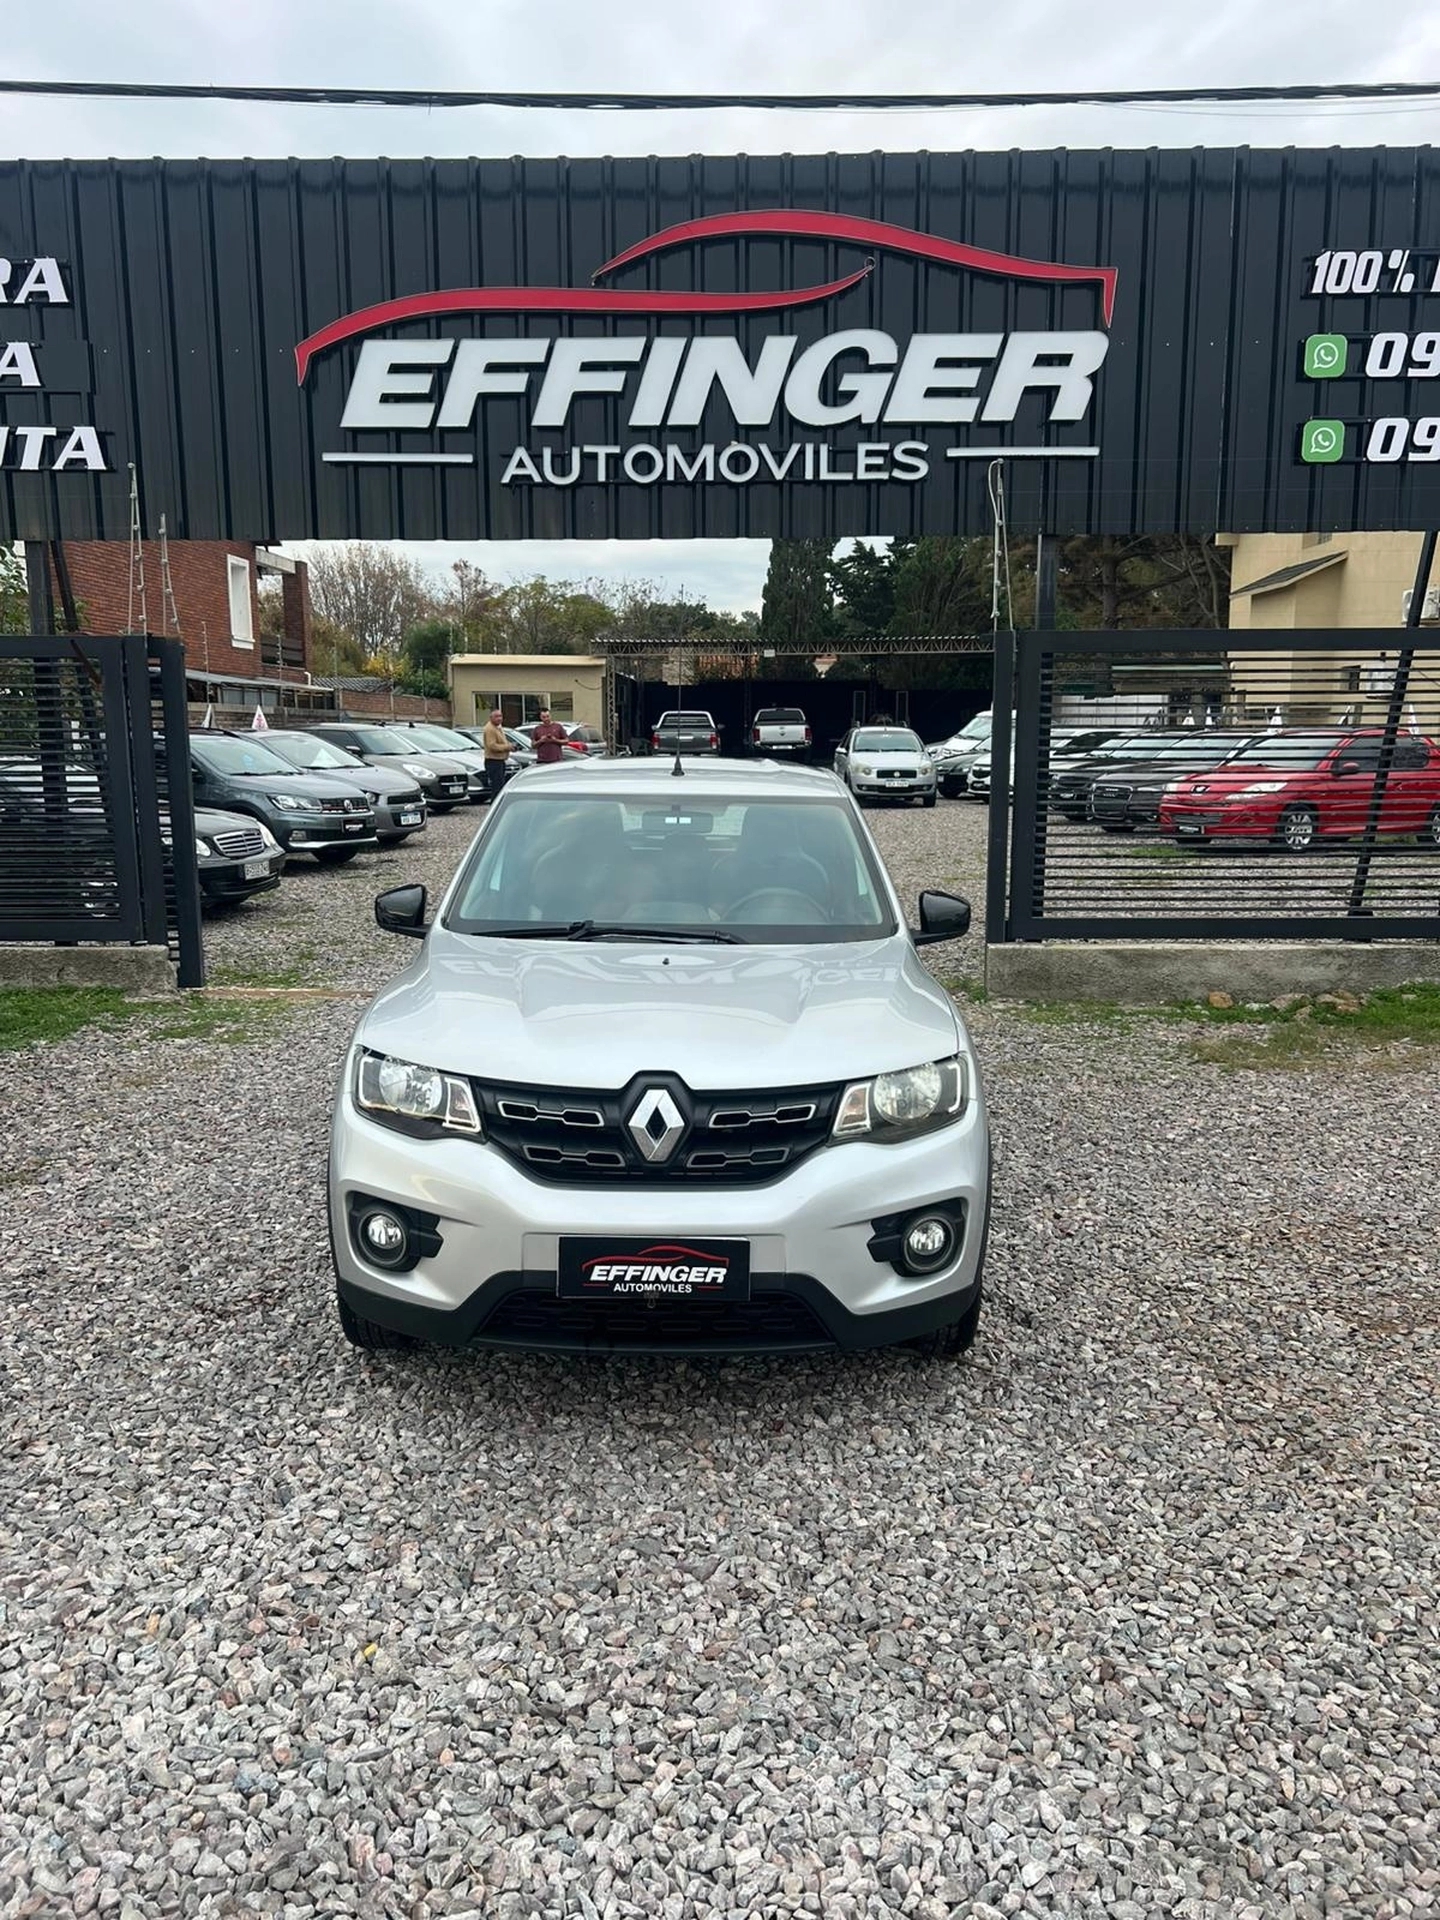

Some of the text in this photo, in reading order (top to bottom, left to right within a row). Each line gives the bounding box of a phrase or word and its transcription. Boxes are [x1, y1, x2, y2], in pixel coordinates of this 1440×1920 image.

[1311, 249, 1415, 294] 100%
[340, 329, 1109, 428] EFFINGER
[589, 1265, 728, 1284] EFFINGER
[613, 1282, 693, 1294] AUTOMOVILES
